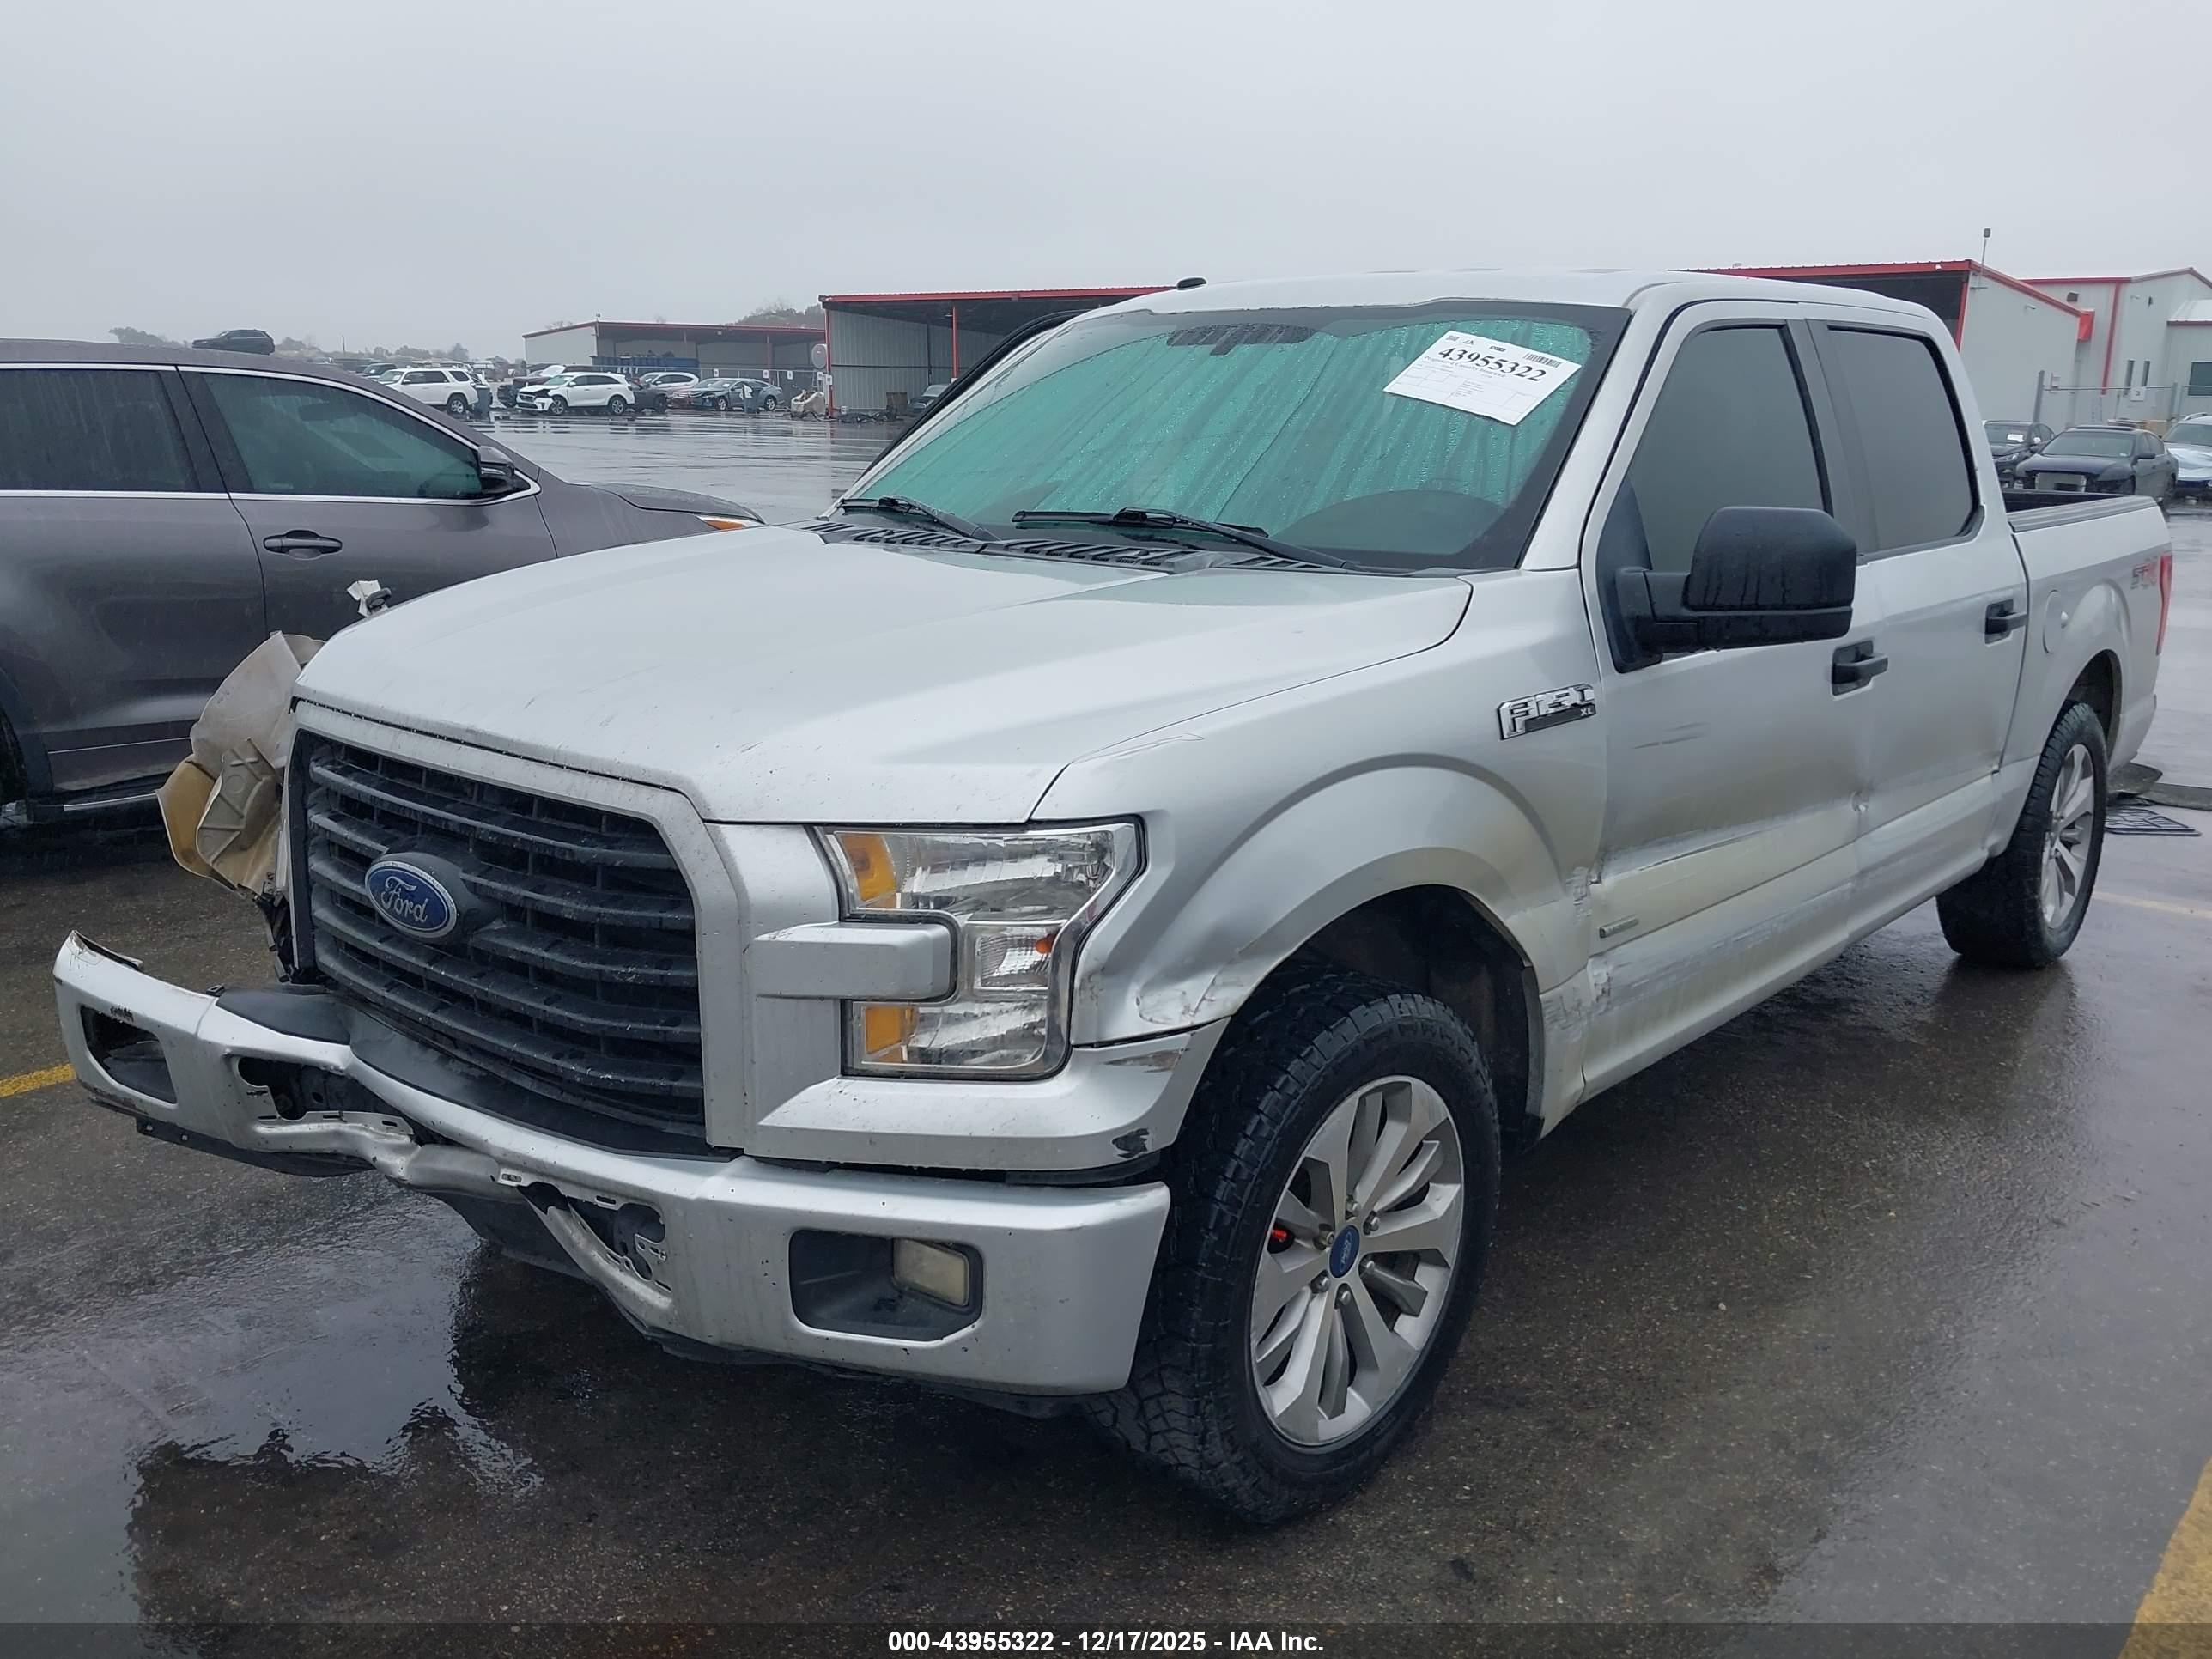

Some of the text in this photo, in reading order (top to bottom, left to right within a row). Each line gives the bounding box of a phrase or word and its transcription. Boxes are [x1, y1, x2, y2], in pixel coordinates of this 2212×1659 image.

[1438, 347, 1547, 381] 43955322
[1580, 706, 1595, 717] XL
[380, 876, 429, 922] Ford
